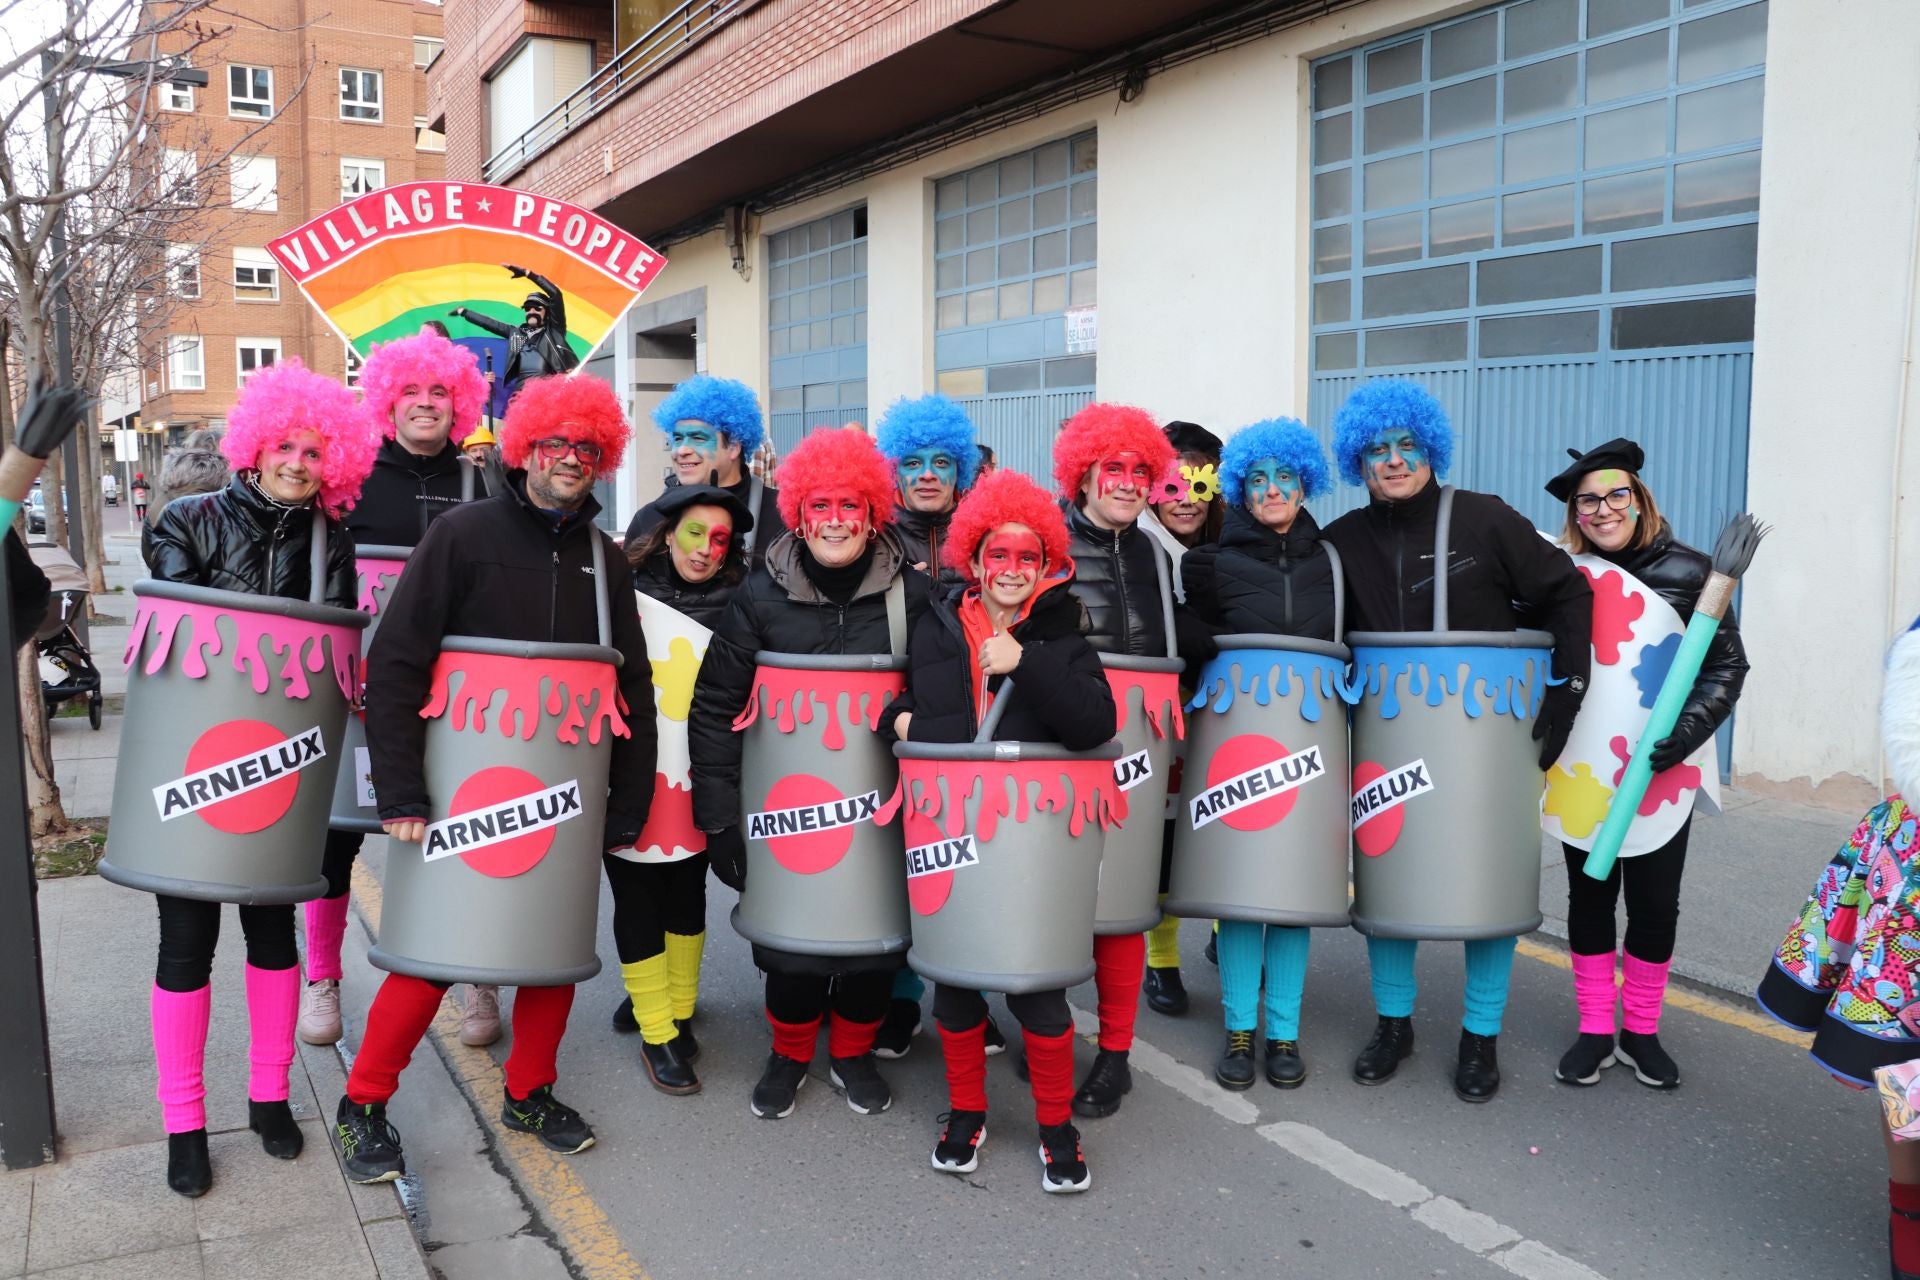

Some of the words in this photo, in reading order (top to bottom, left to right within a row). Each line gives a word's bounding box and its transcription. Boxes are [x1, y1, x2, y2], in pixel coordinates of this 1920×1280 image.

[278, 185, 464, 273] VILLAGE
[512, 194, 654, 285] PEOPLE
[164, 731, 321, 816] ARNELUX
[1195, 750, 1321, 824] ARNELUX
[426, 786, 579, 856] ARNELUX
[751, 792, 877, 837] ARNELUX
